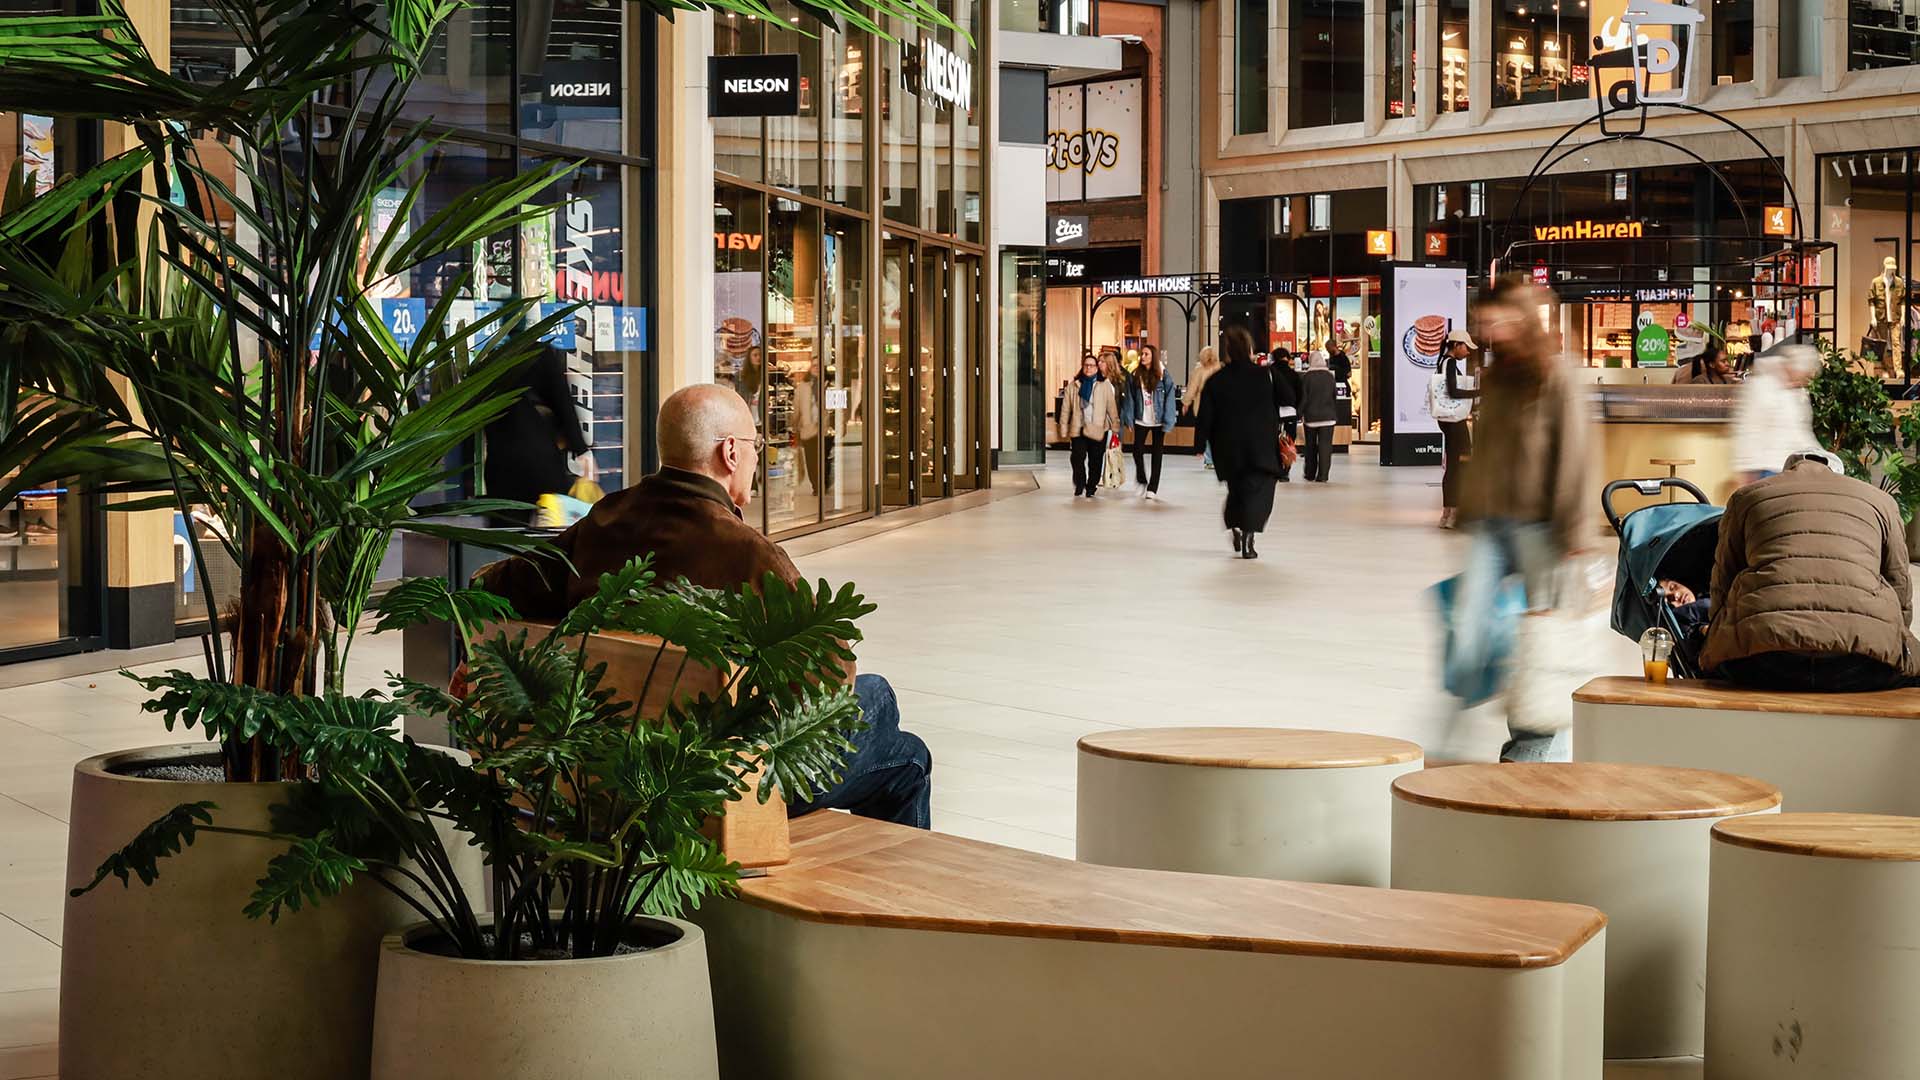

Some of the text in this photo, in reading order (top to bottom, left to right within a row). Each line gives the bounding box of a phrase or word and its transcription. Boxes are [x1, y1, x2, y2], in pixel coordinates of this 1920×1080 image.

[925, 37, 972, 112] NELSON
[724, 78, 789, 93] NELSON
[1056, 219, 1083, 236] Etos
[1535, 220, 1643, 240] vanHaren
[1102, 277, 1191, 294] THE HEALTH HOUSE
[1639, 318, 1652, 326] NU
